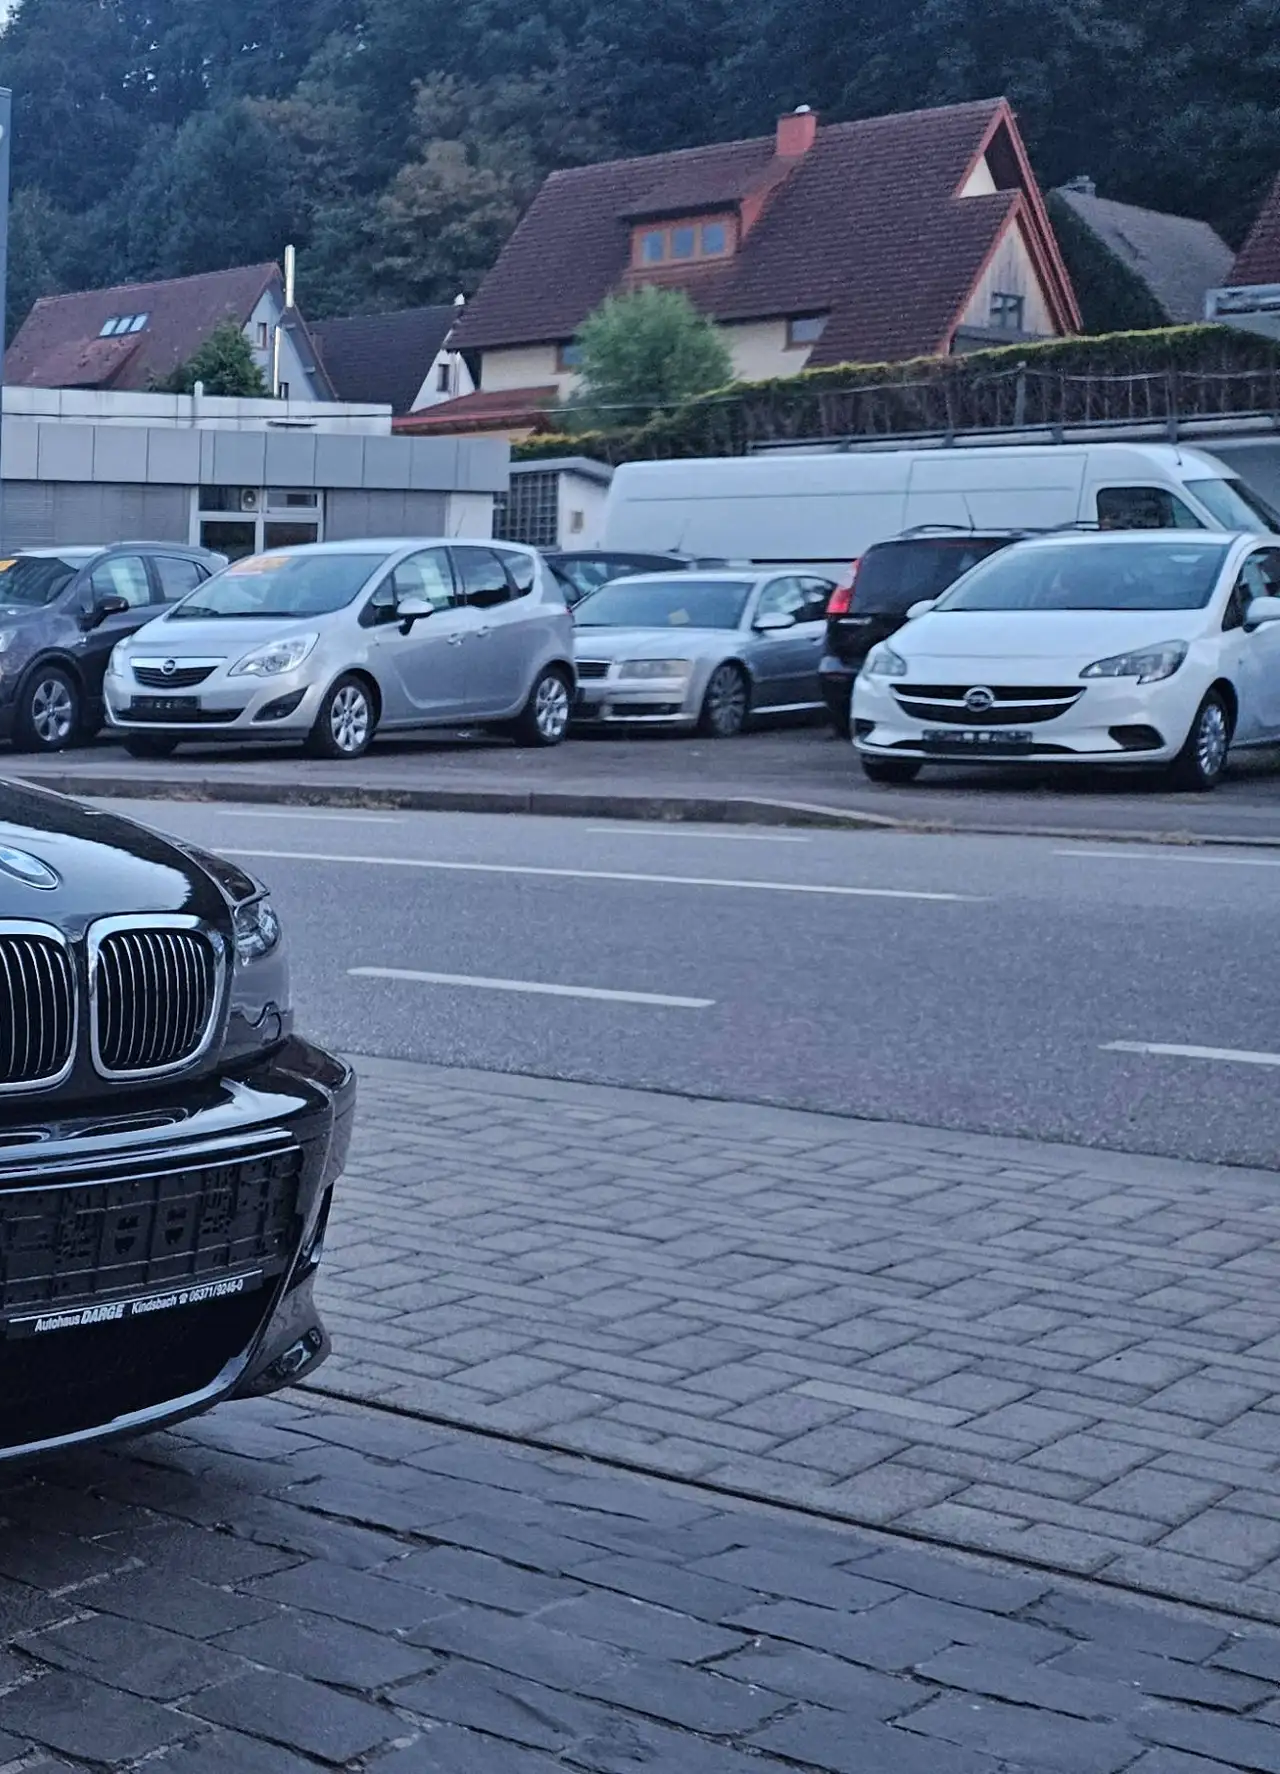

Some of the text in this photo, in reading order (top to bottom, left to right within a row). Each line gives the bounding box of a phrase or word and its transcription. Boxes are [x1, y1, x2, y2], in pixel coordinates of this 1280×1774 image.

[34, 1313, 81, 1333] Autohaus
[80, 1303, 126, 1325] DARGE
[131, 1295, 177, 1314] Kindsbach
